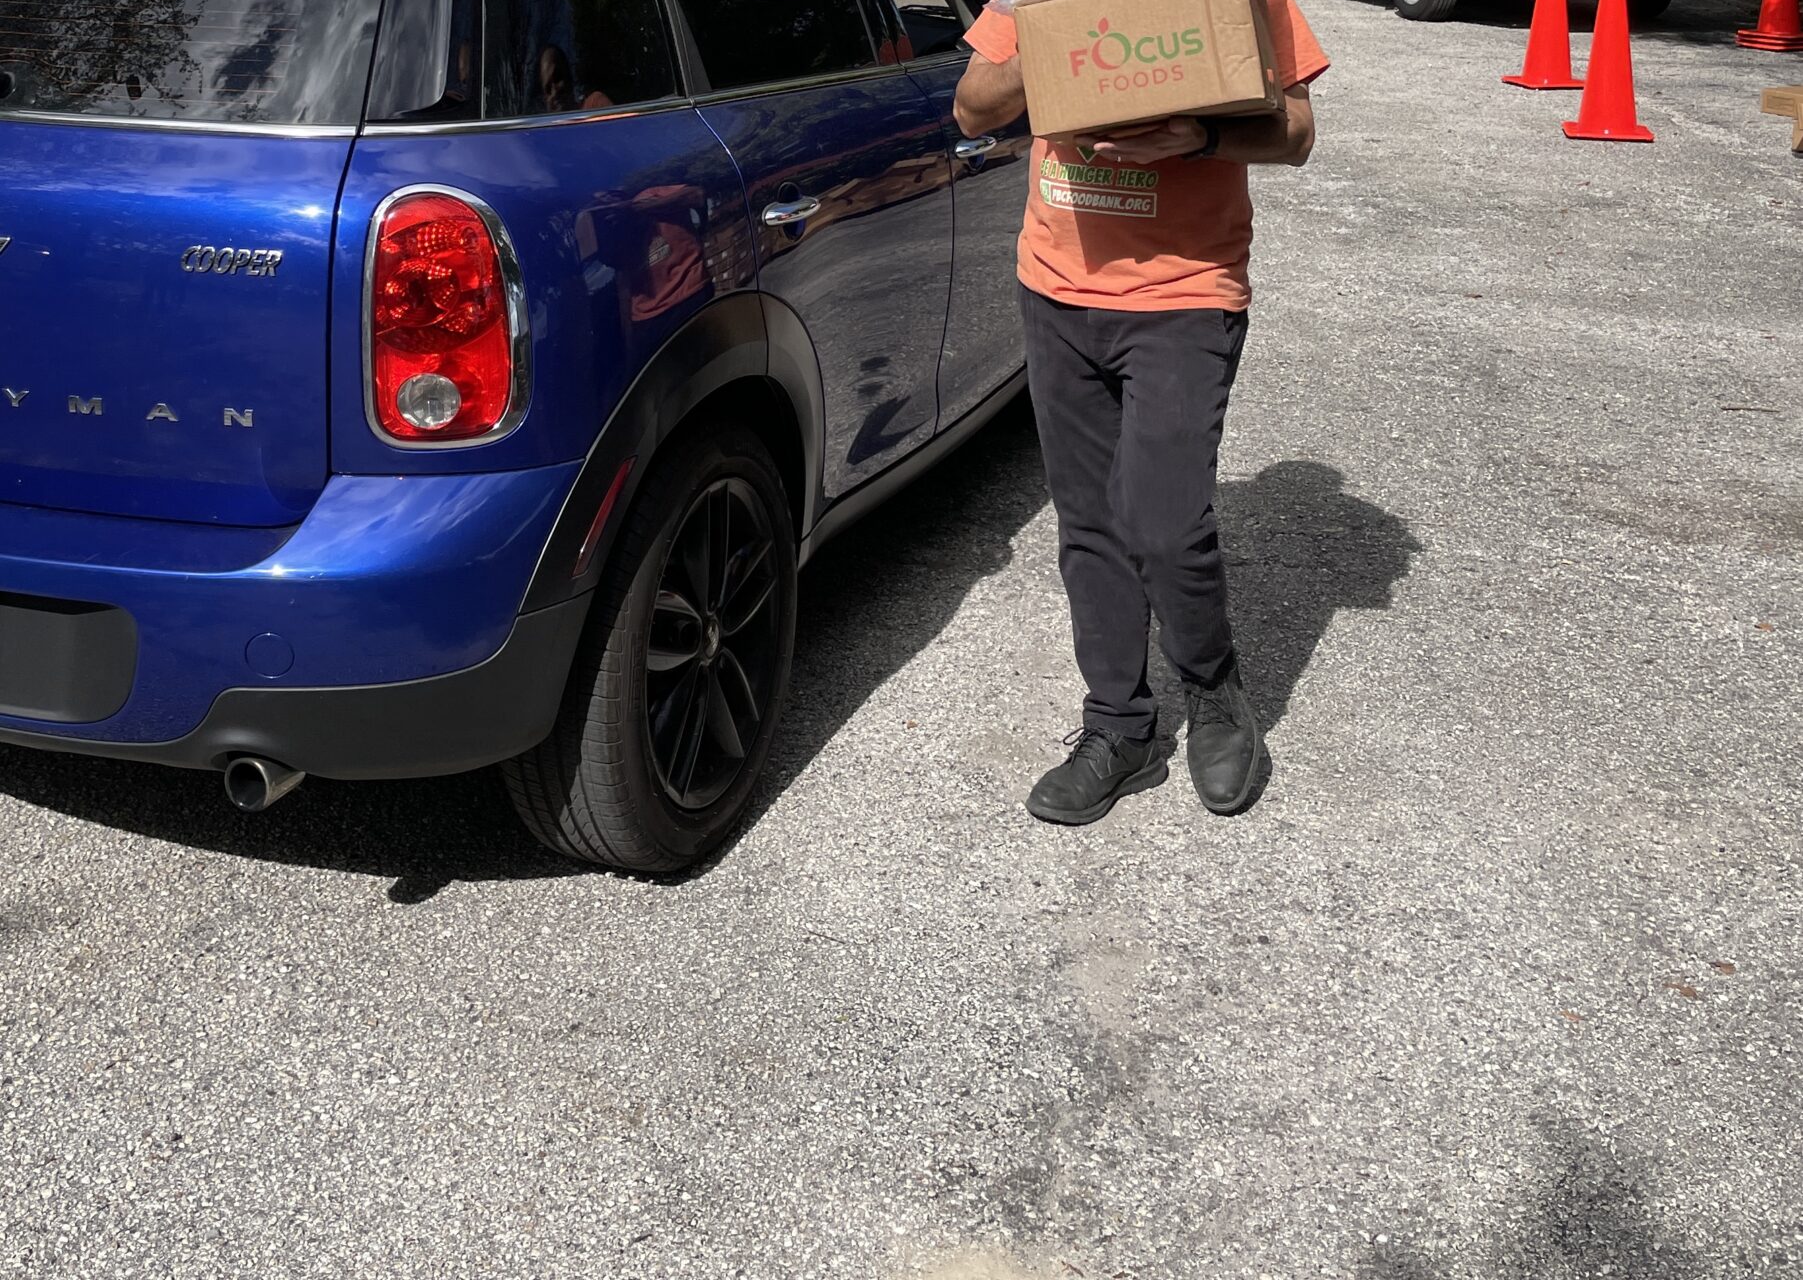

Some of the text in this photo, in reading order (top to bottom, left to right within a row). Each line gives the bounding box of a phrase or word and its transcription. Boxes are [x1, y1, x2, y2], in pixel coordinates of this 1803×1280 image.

[1070, 27, 1204, 77] FOCUS
[1098, 64, 1185, 95] FOODS
[1049, 161, 1058, 179] A
[1059, 163, 1114, 187] HUNGER
[1116, 169, 1159, 189] HERO
[1052, 188, 1151, 211] PBCFOODBANK.ORG
[181, 244, 283, 277] COOPER
